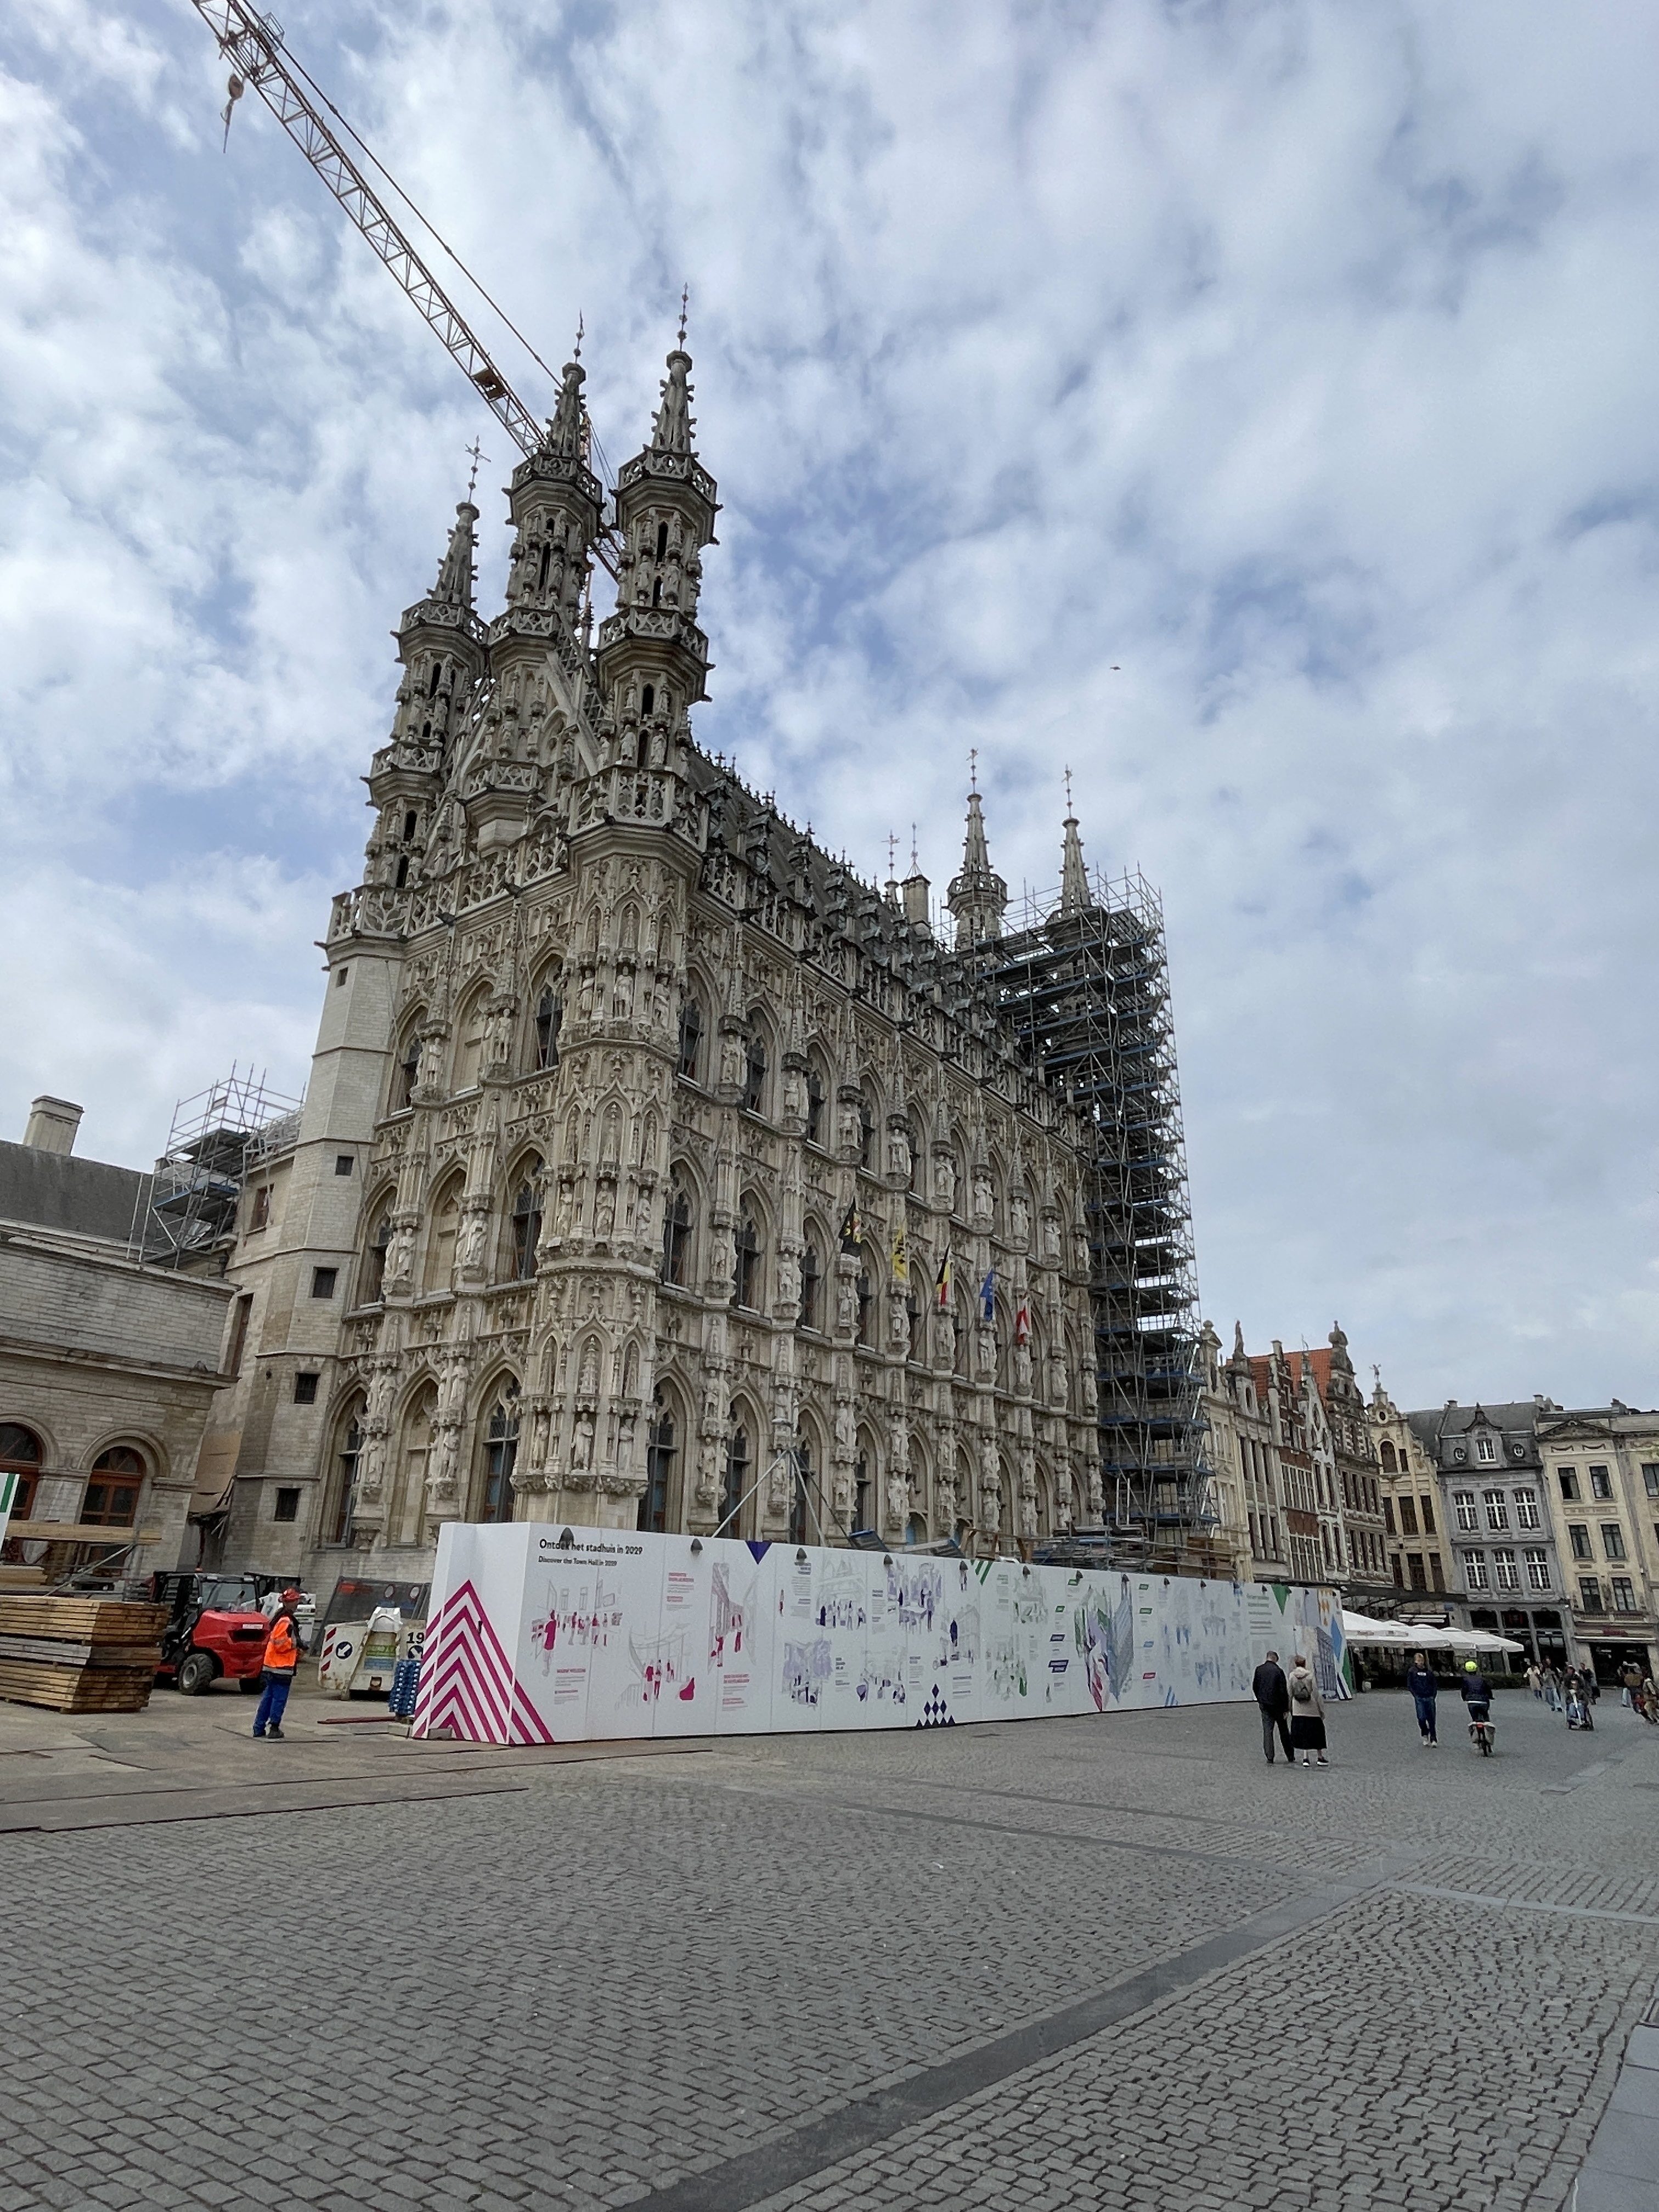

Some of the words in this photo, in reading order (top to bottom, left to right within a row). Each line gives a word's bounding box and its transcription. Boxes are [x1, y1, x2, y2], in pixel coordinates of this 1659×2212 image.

[540, 1538, 570, 1550] Ontdek
[571, 1541, 584, 1551] het
[586, 1543, 616, 1553] stadhuis
[617, 1544, 623, 1554] in
[625, 1545, 643, 1555] 2029
[407, 1632, 425, 1644] 19
